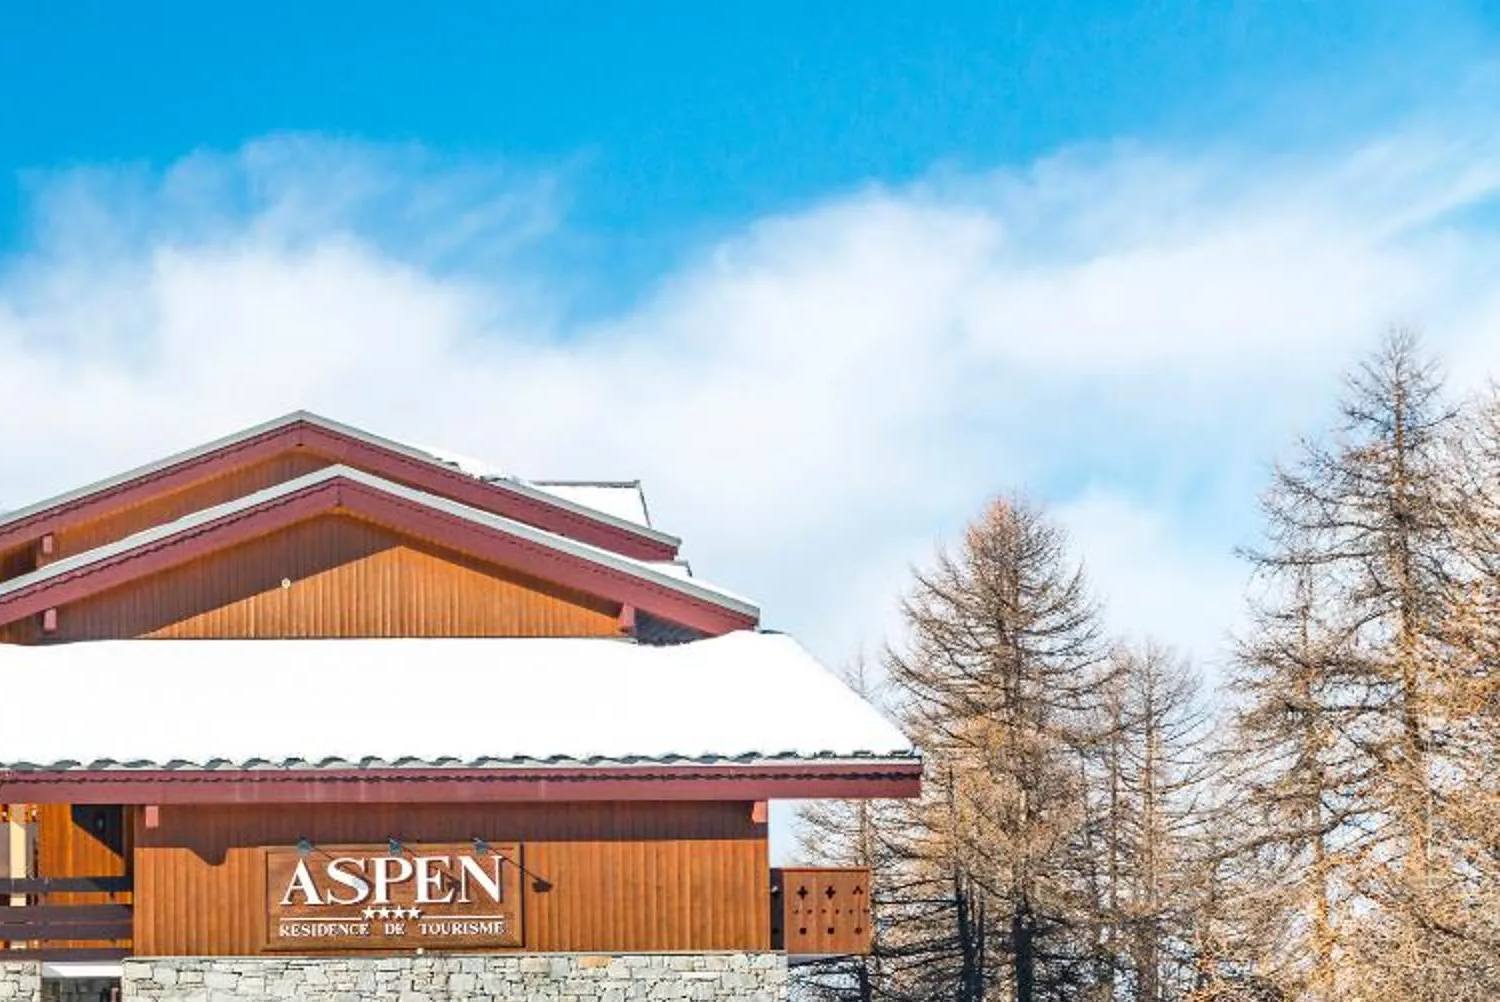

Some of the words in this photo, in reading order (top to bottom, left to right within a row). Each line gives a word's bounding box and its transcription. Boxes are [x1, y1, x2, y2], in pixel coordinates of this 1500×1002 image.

[279, 855, 503, 905] ASPEN
[279, 923, 370, 937] RESIDENCE
[384, 922, 405, 935] DE
[418, 921, 504, 935] TOURISME
